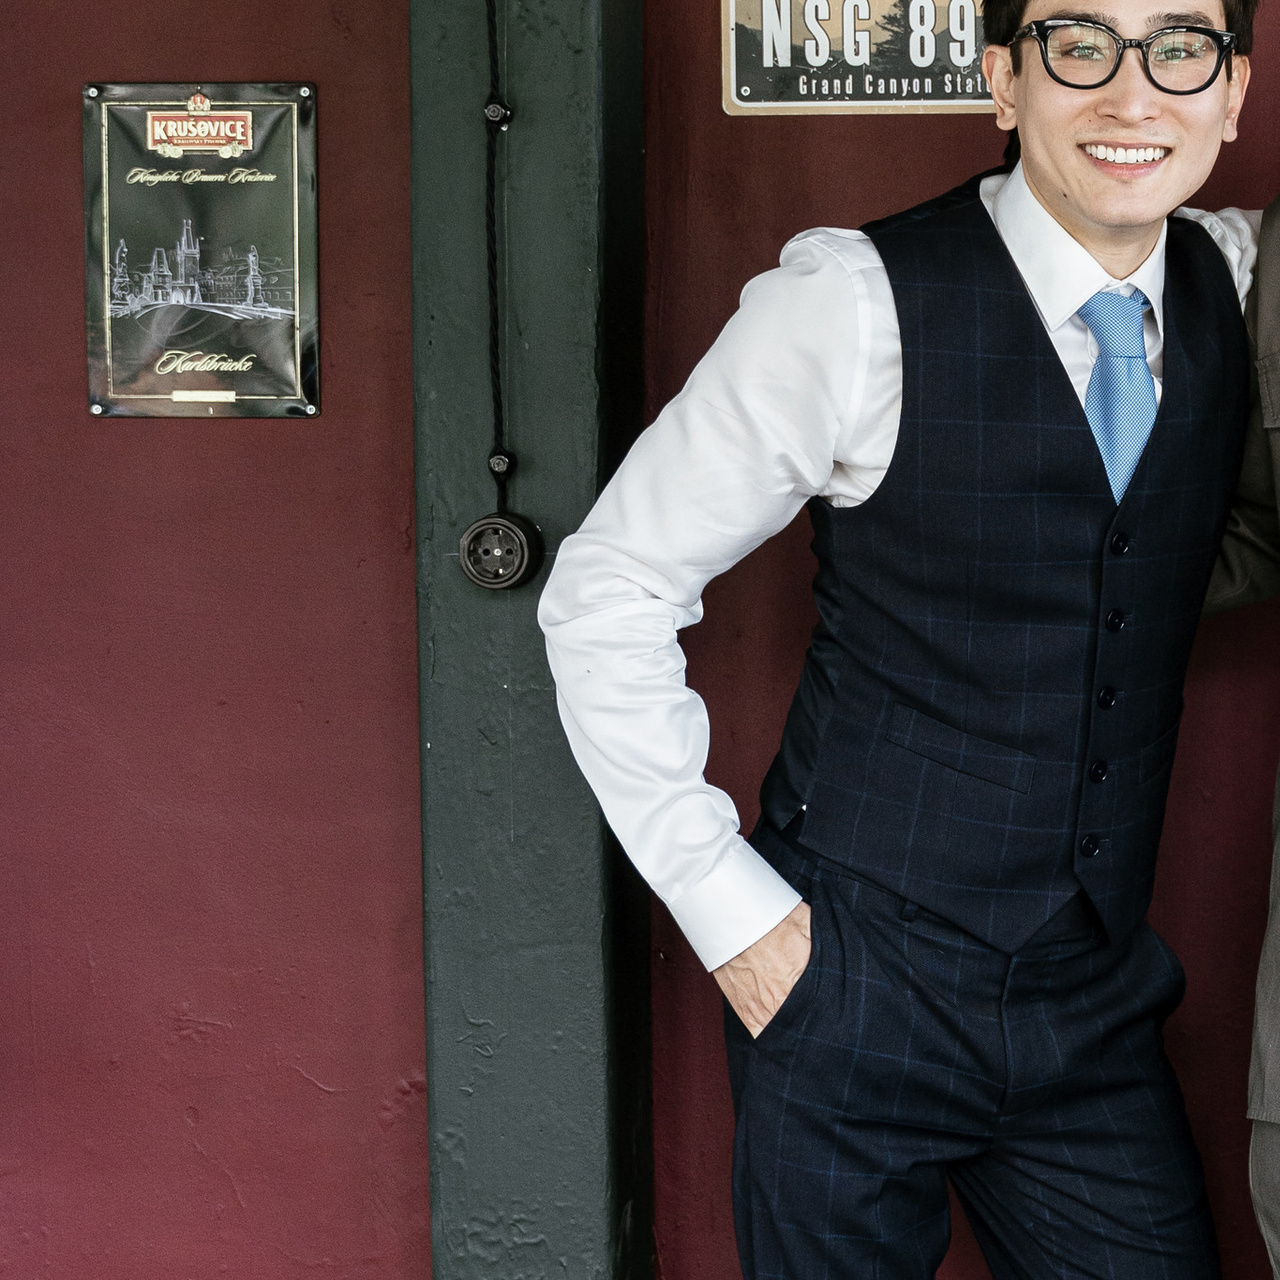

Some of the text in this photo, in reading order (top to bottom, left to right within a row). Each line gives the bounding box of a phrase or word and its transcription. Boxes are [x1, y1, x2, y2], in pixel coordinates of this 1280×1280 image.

[799, 75, 853, 95] Grand
[865, 75, 933, 97] Canyon
[153, 117, 247, 141] KRUŠOVICE
[156, 349, 258, 375] Karlsbrücke
